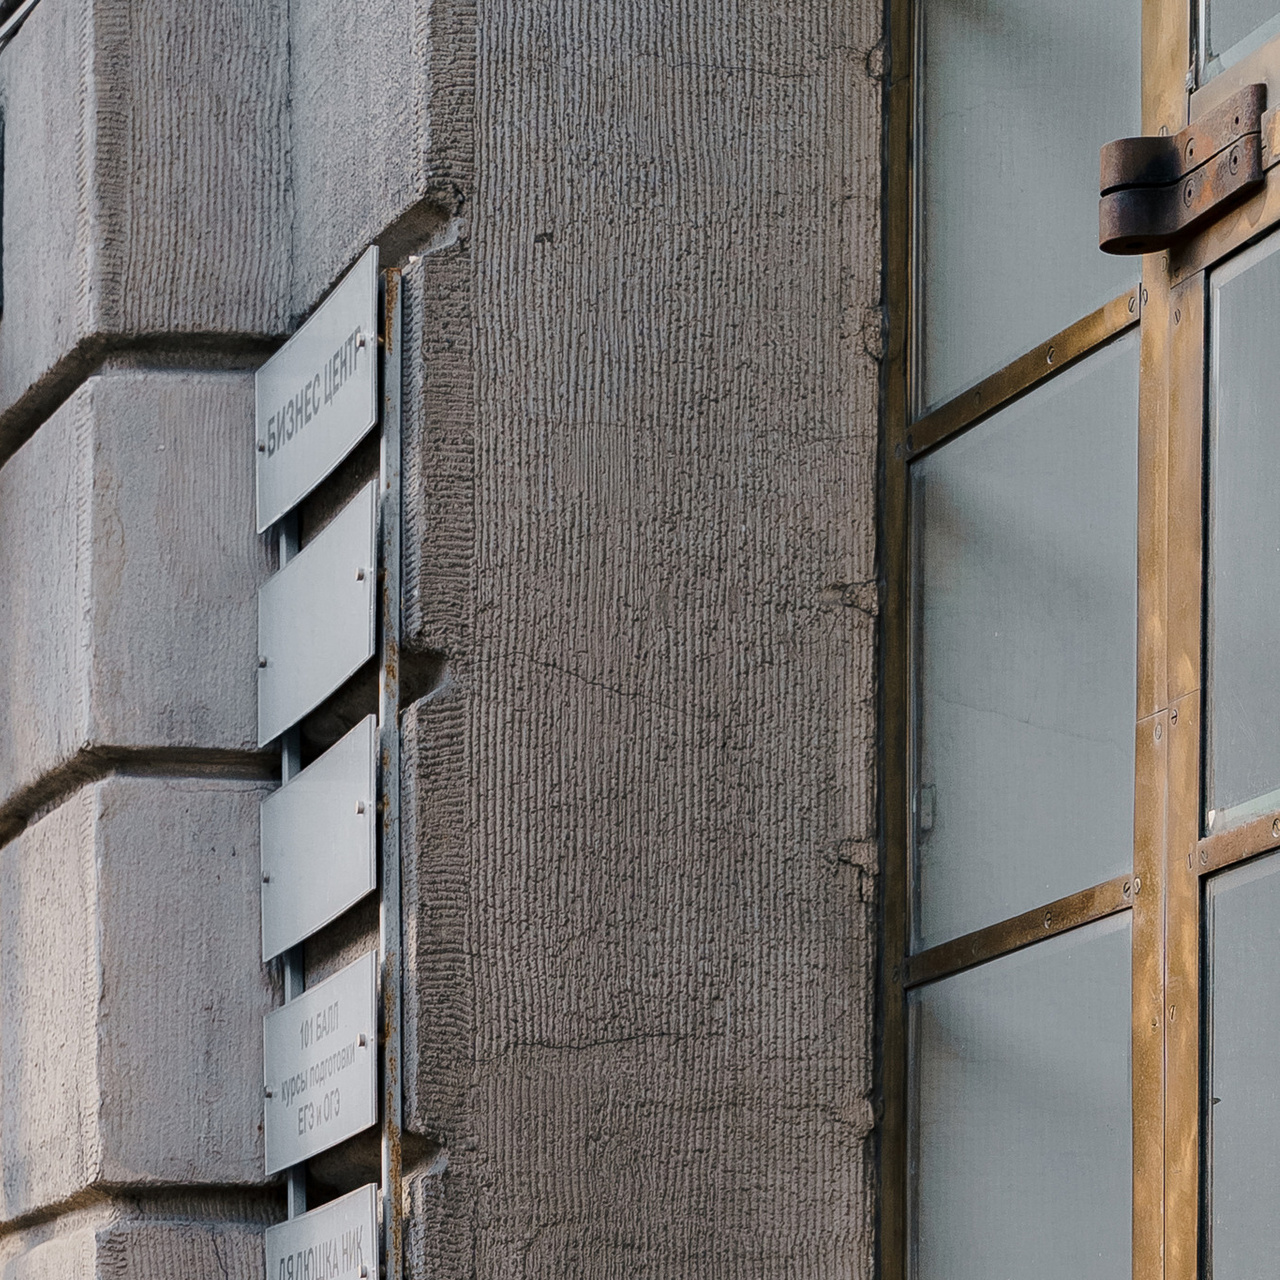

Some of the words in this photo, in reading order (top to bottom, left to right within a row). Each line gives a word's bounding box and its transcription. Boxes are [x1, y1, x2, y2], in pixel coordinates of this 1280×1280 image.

[266, 373, 321, 459] БИЗНЕС
[324, 325, 361, 406] ЦЕНТР
[300, 1017, 313, 1050] 101
[316, 1000, 339, 1042] БАЛЛ
[281, 1069, 308, 1108] курсы
[309, 1042, 355, 1088] подготовки
[298, 1101, 315, 1136] ЕГЭ
[323, 1087, 340, 1123] ОГЭ
[341, 1224, 364, 1274] НИК
